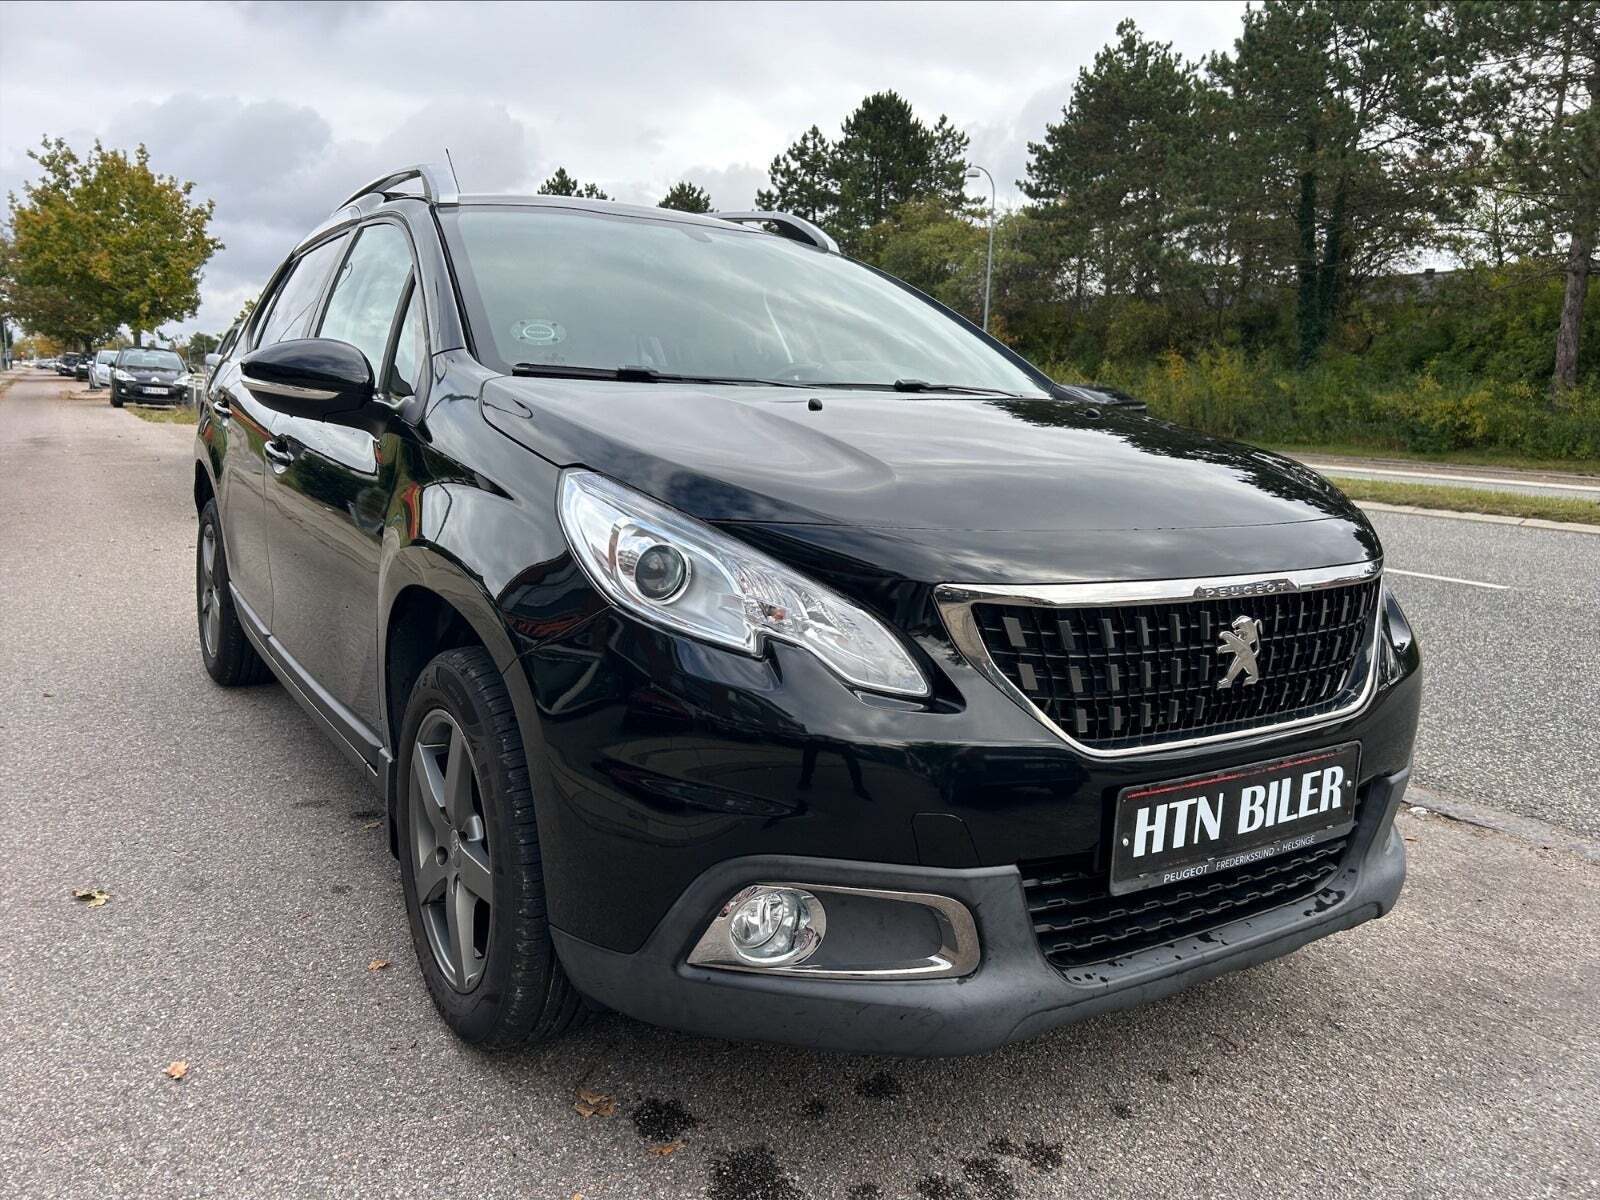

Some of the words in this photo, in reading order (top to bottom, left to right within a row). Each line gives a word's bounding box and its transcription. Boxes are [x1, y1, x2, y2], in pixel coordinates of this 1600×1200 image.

[1205, 582, 1286, 598] PEUGEOT
[1132, 792, 1224, 858] HTN
[1237, 765, 1344, 835] BILER
[1163, 863, 1209, 883] PEUGEOT
[1215, 847, 1275, 870] FREDERIKSSUND
[1282, 834, 1316, 852] HELSINGE
